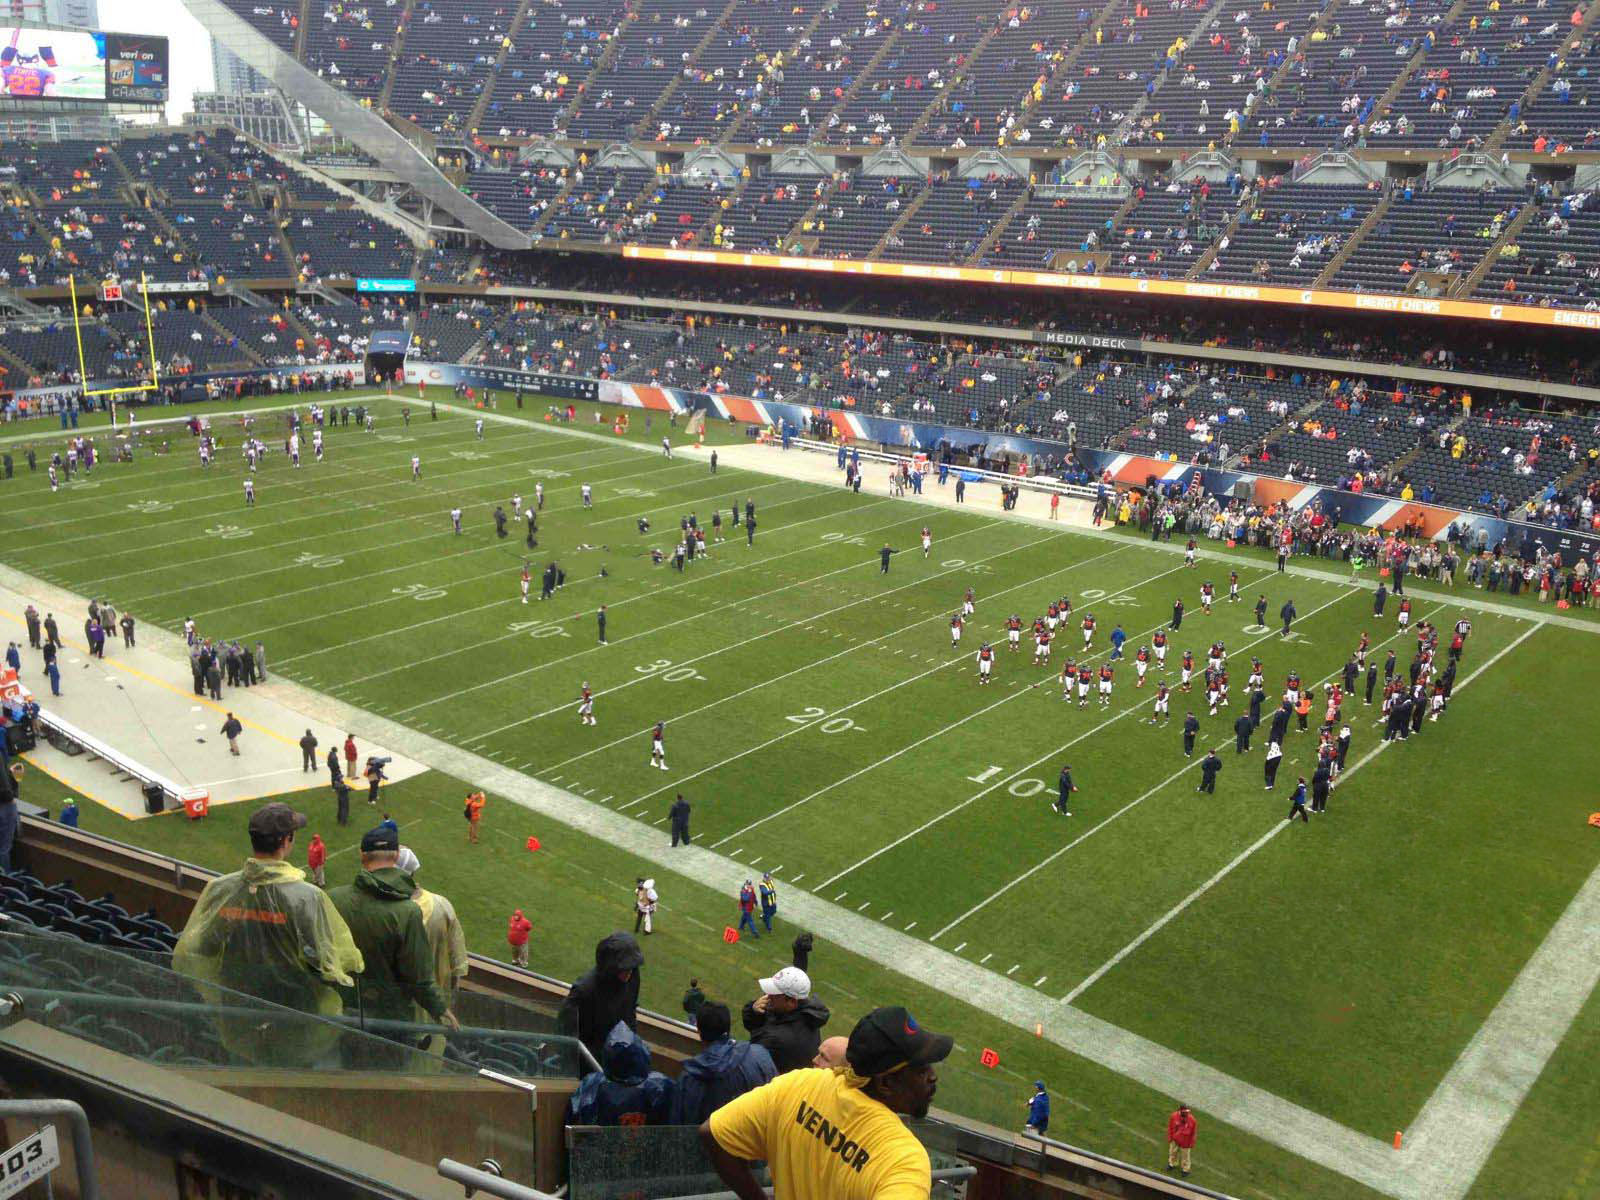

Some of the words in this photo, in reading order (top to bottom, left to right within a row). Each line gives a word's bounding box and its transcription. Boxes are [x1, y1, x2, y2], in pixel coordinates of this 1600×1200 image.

[1046, 332, 1087, 346] MEDIA
[1092, 337, 1127, 349] DECK
[507, 620, 565, 638] 40
[635, 659, 697, 682] 30
[785, 707, 854, 734] 20
[966, 765, 1045, 797] 10
[192, 801, 204, 812] G
[796, 1100, 870, 1173] VENDOR
